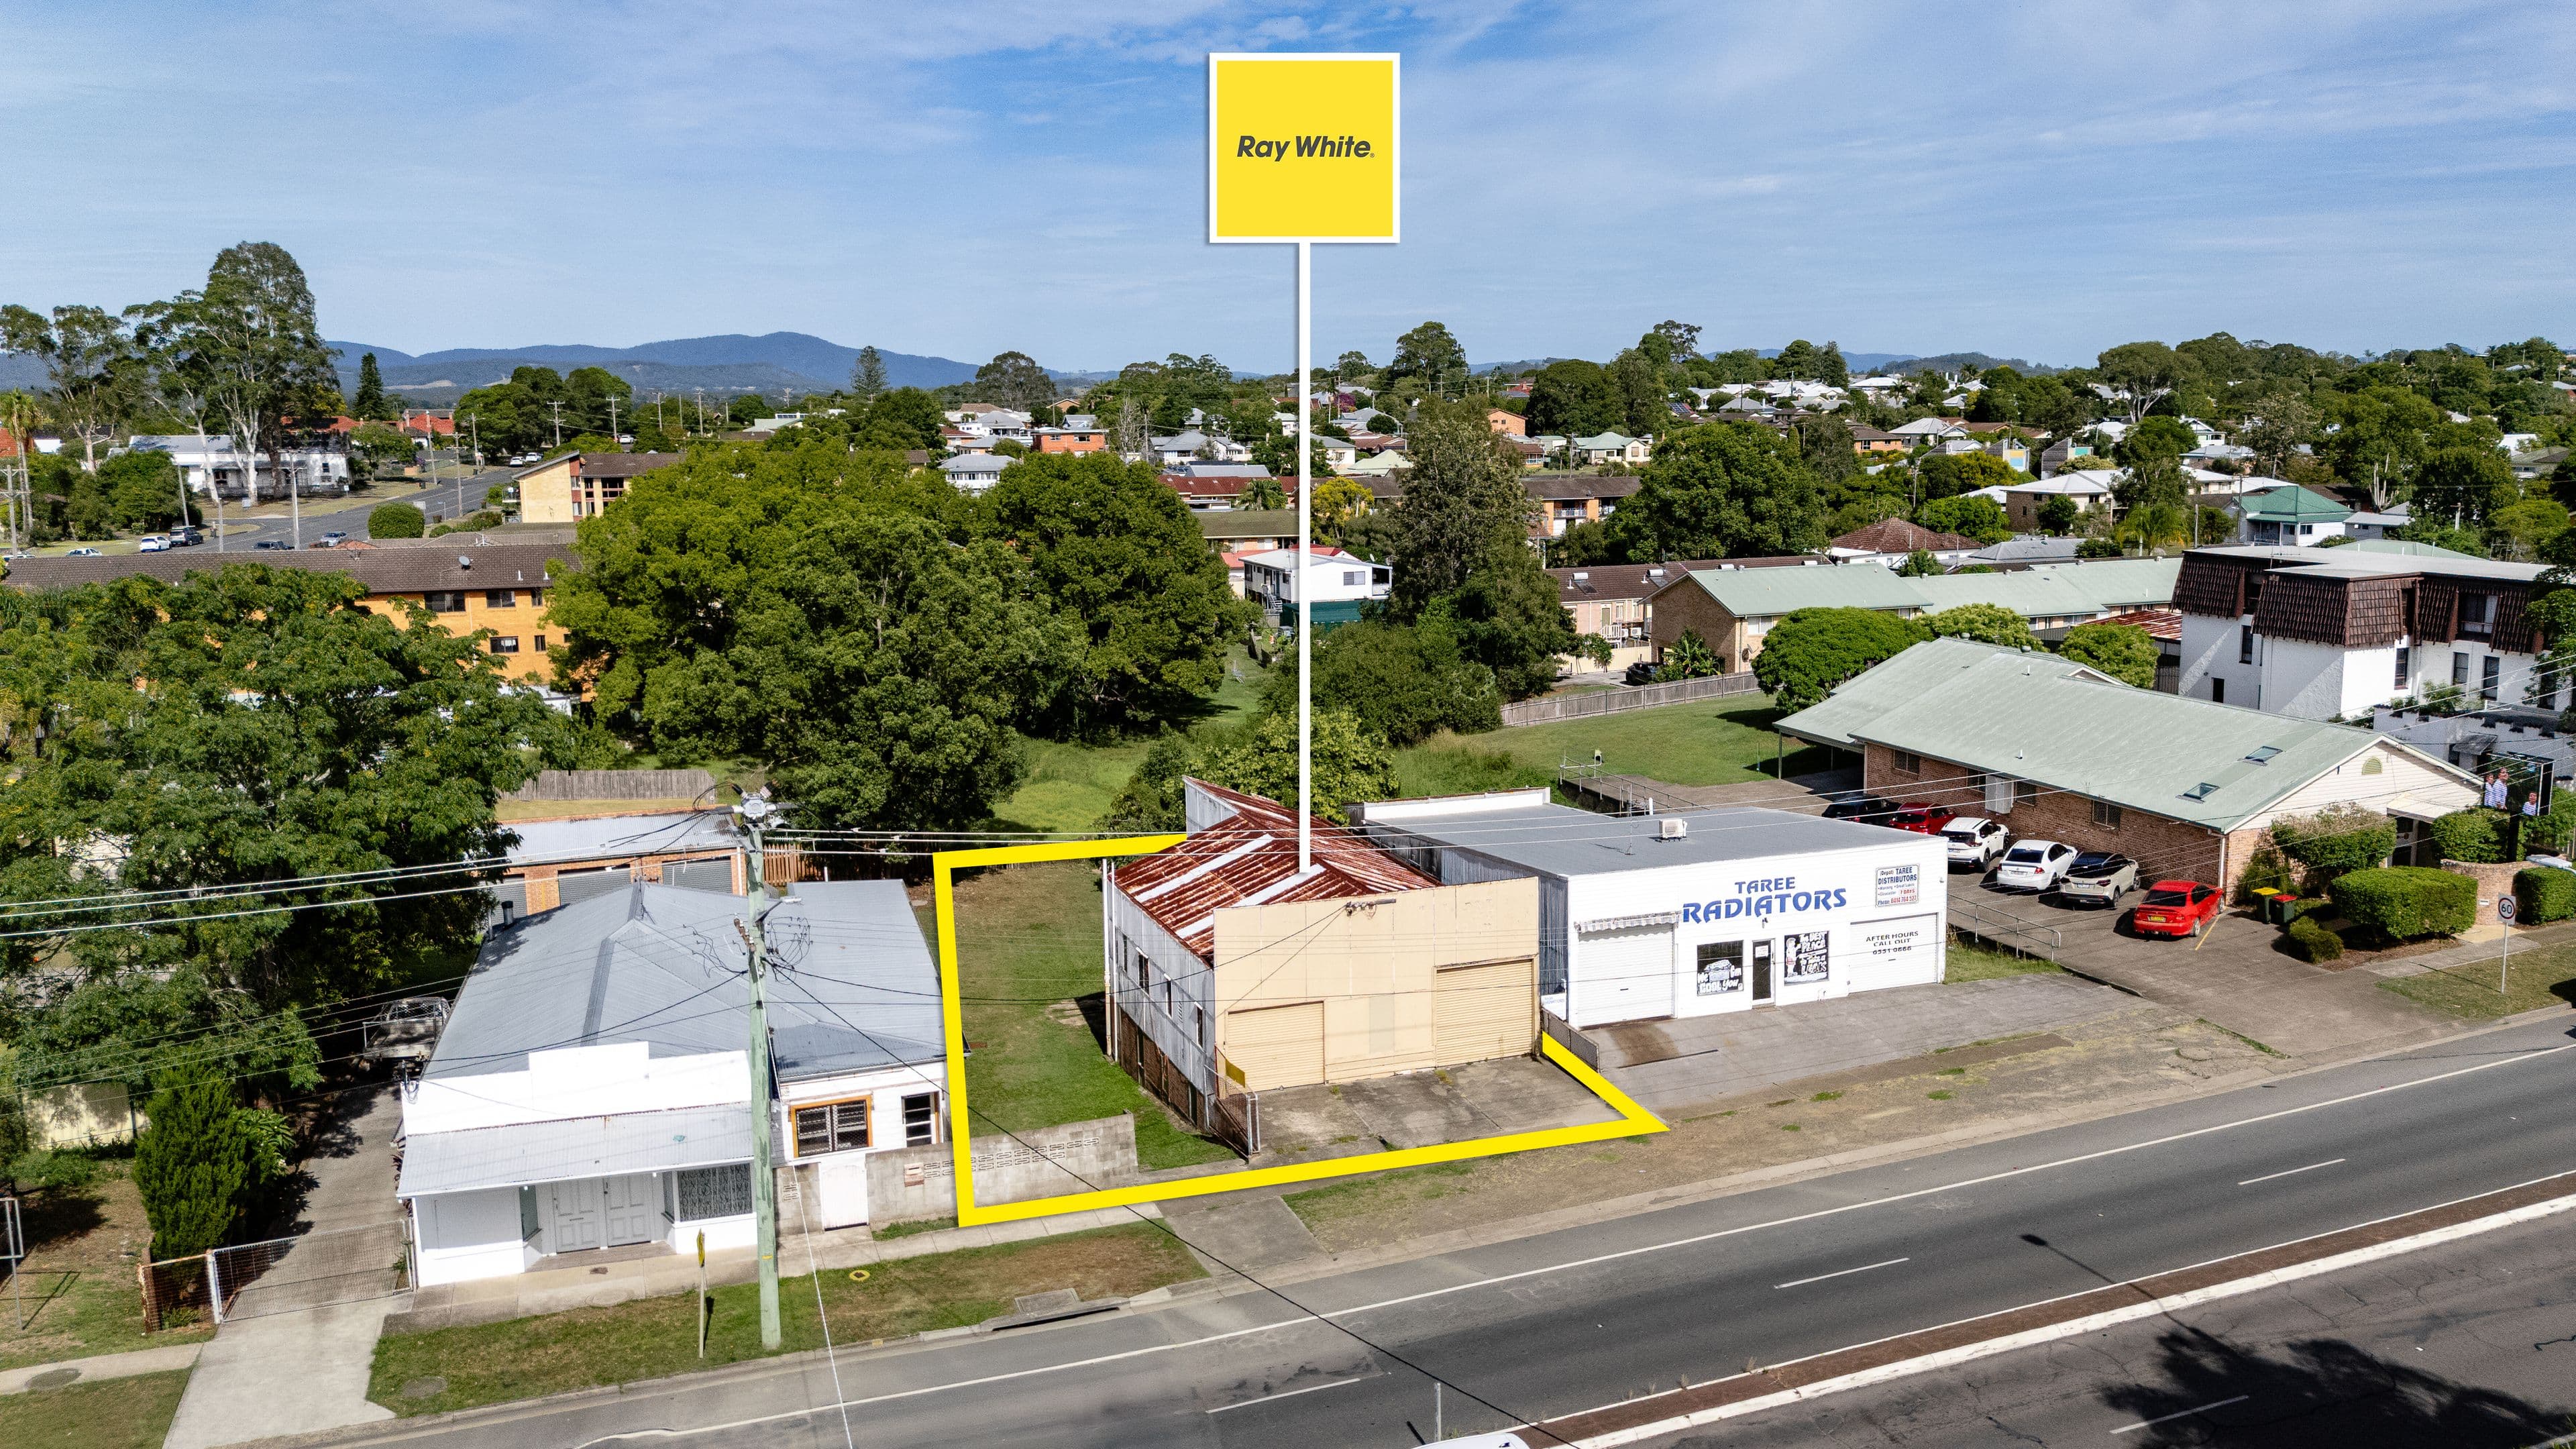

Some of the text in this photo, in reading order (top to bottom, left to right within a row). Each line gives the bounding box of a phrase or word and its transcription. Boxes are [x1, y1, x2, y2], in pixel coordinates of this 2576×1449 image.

[1896, 867, 1913, 875] TAREE
[1878, 874, 1917, 885] DISTRIBUTORS
[1735, 877, 1795, 894] TAREE
[1682, 888, 1847, 924] RADIATORS
[2501, 904, 2512, 914] 60
[1866, 931, 1919, 942] AFTER HOURS
